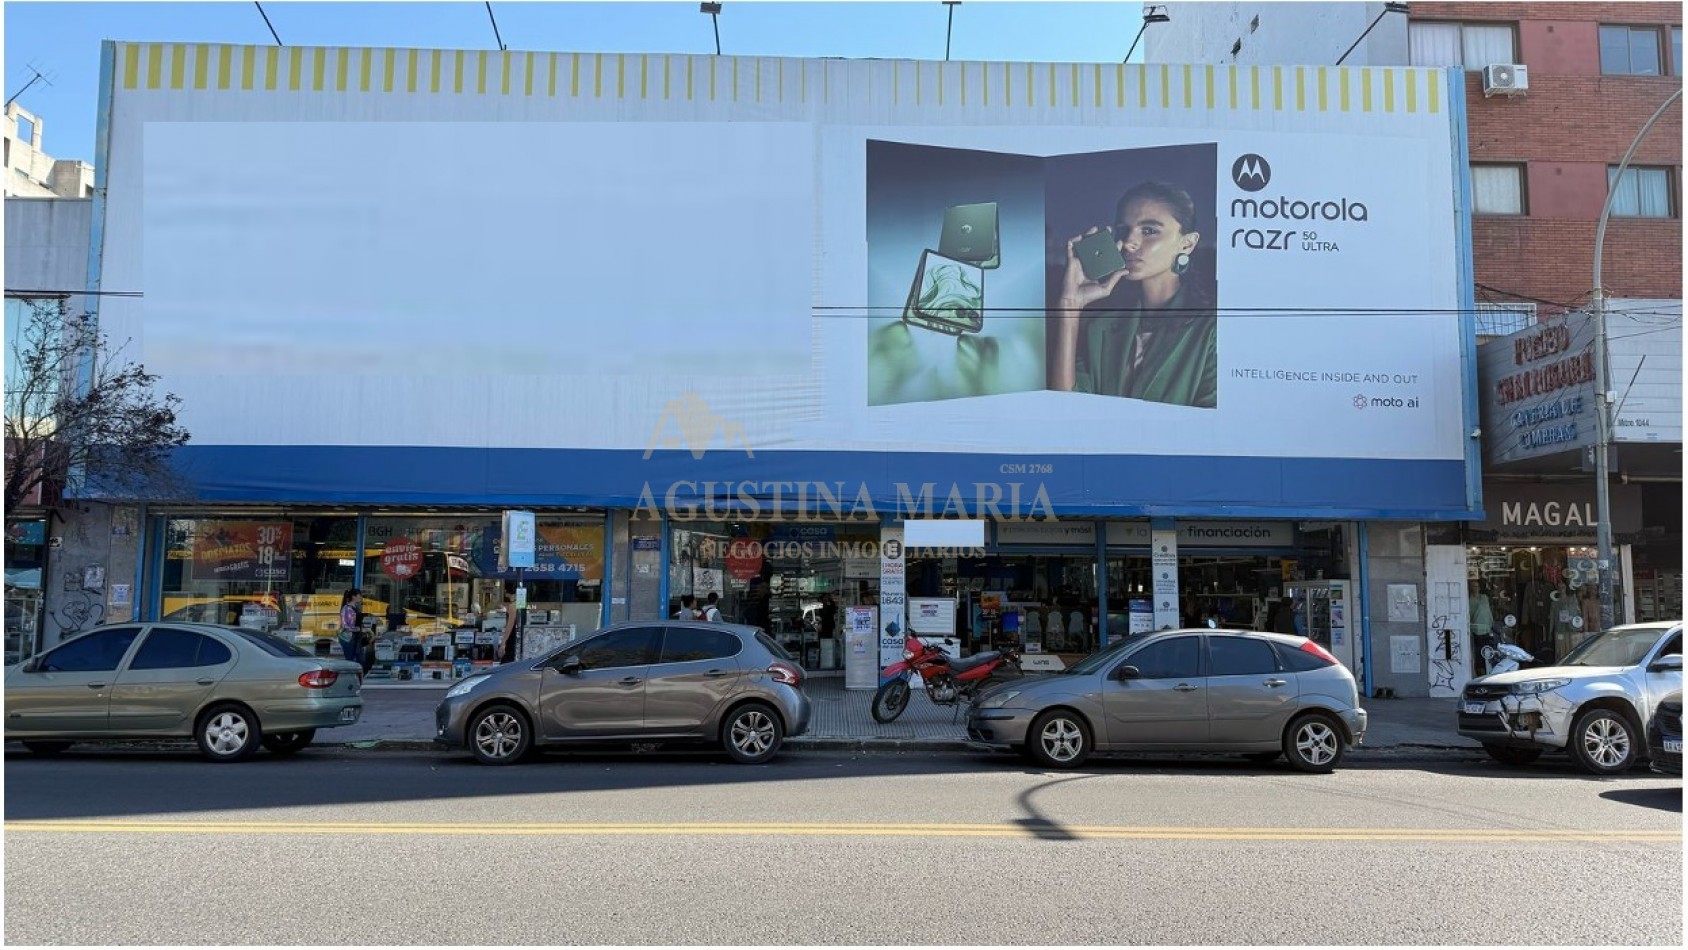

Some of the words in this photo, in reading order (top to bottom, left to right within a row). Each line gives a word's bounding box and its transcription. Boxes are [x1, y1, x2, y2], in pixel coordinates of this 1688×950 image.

[1231, 196, 1368, 221] motorola
[1231, 229, 1296, 250] razr
[1303, 231, 1317, 240] 50
[1302, 241, 1339, 251] ULTRA
[1231, 368, 1317, 382] INTELLIGENCE
[1321, 372, 1359, 383] INSIDE
[1363, 373, 1389, 384] AND
[1393, 375, 1418, 384] OUT
[1371, 397, 1403, 408] moto
[1407, 397, 1419, 408] ai
[368, 526, 392, 537] BGH
[799, 527, 828, 536] casa
[1186, 525, 1271, 539] financiación
[538, 543, 594, 552] PERSONALES
[887, 543, 900, 558] E
[258, 546, 273, 565] 18
[384, 551, 419, 565] gratis
[525, 562, 556, 573] 2658
[558, 563, 586, 572] 4715
[882, 638, 904, 646] casa
